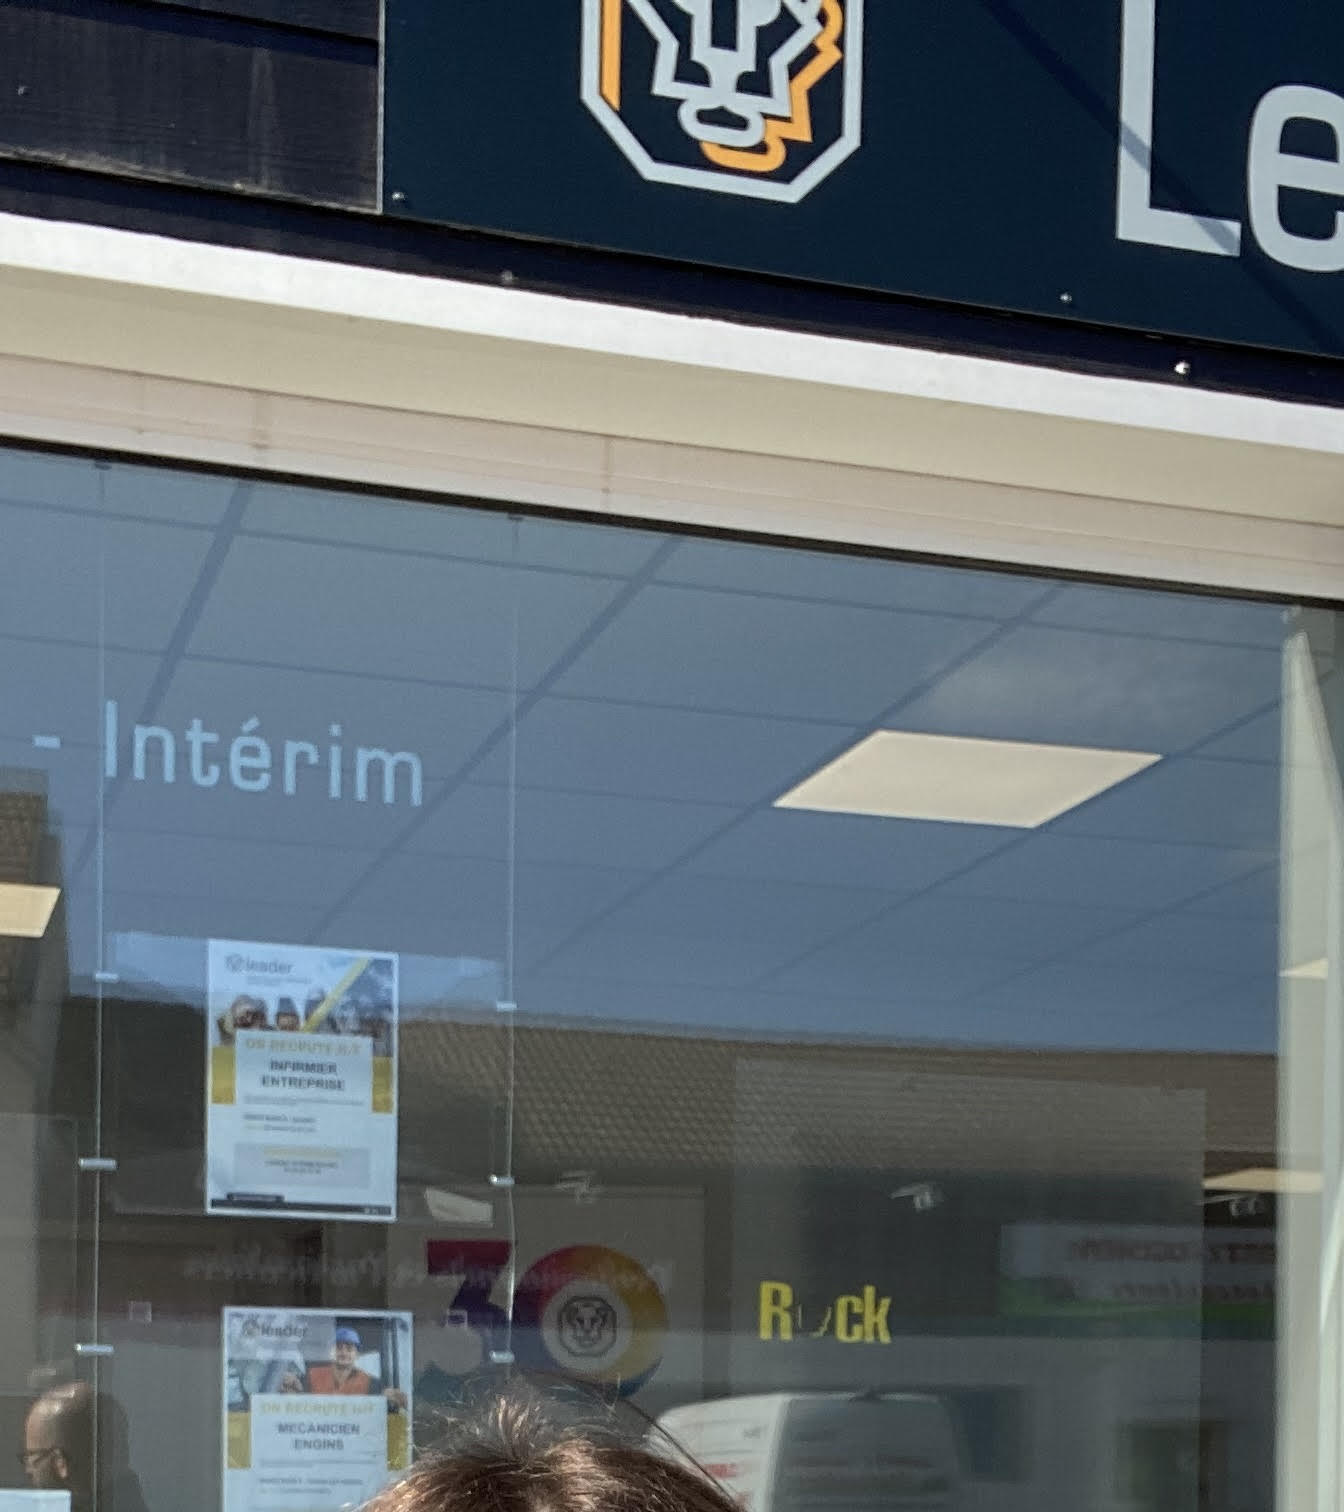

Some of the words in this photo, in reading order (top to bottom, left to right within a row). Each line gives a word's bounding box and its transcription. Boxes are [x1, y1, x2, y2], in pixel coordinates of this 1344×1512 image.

[104, 700, 424, 807] Intérim
[759, 1279, 892, 1344] Rck
[278, 1423, 360, 1435] MECANICIEN
[294, 1439, 345, 1451] ENGINS
